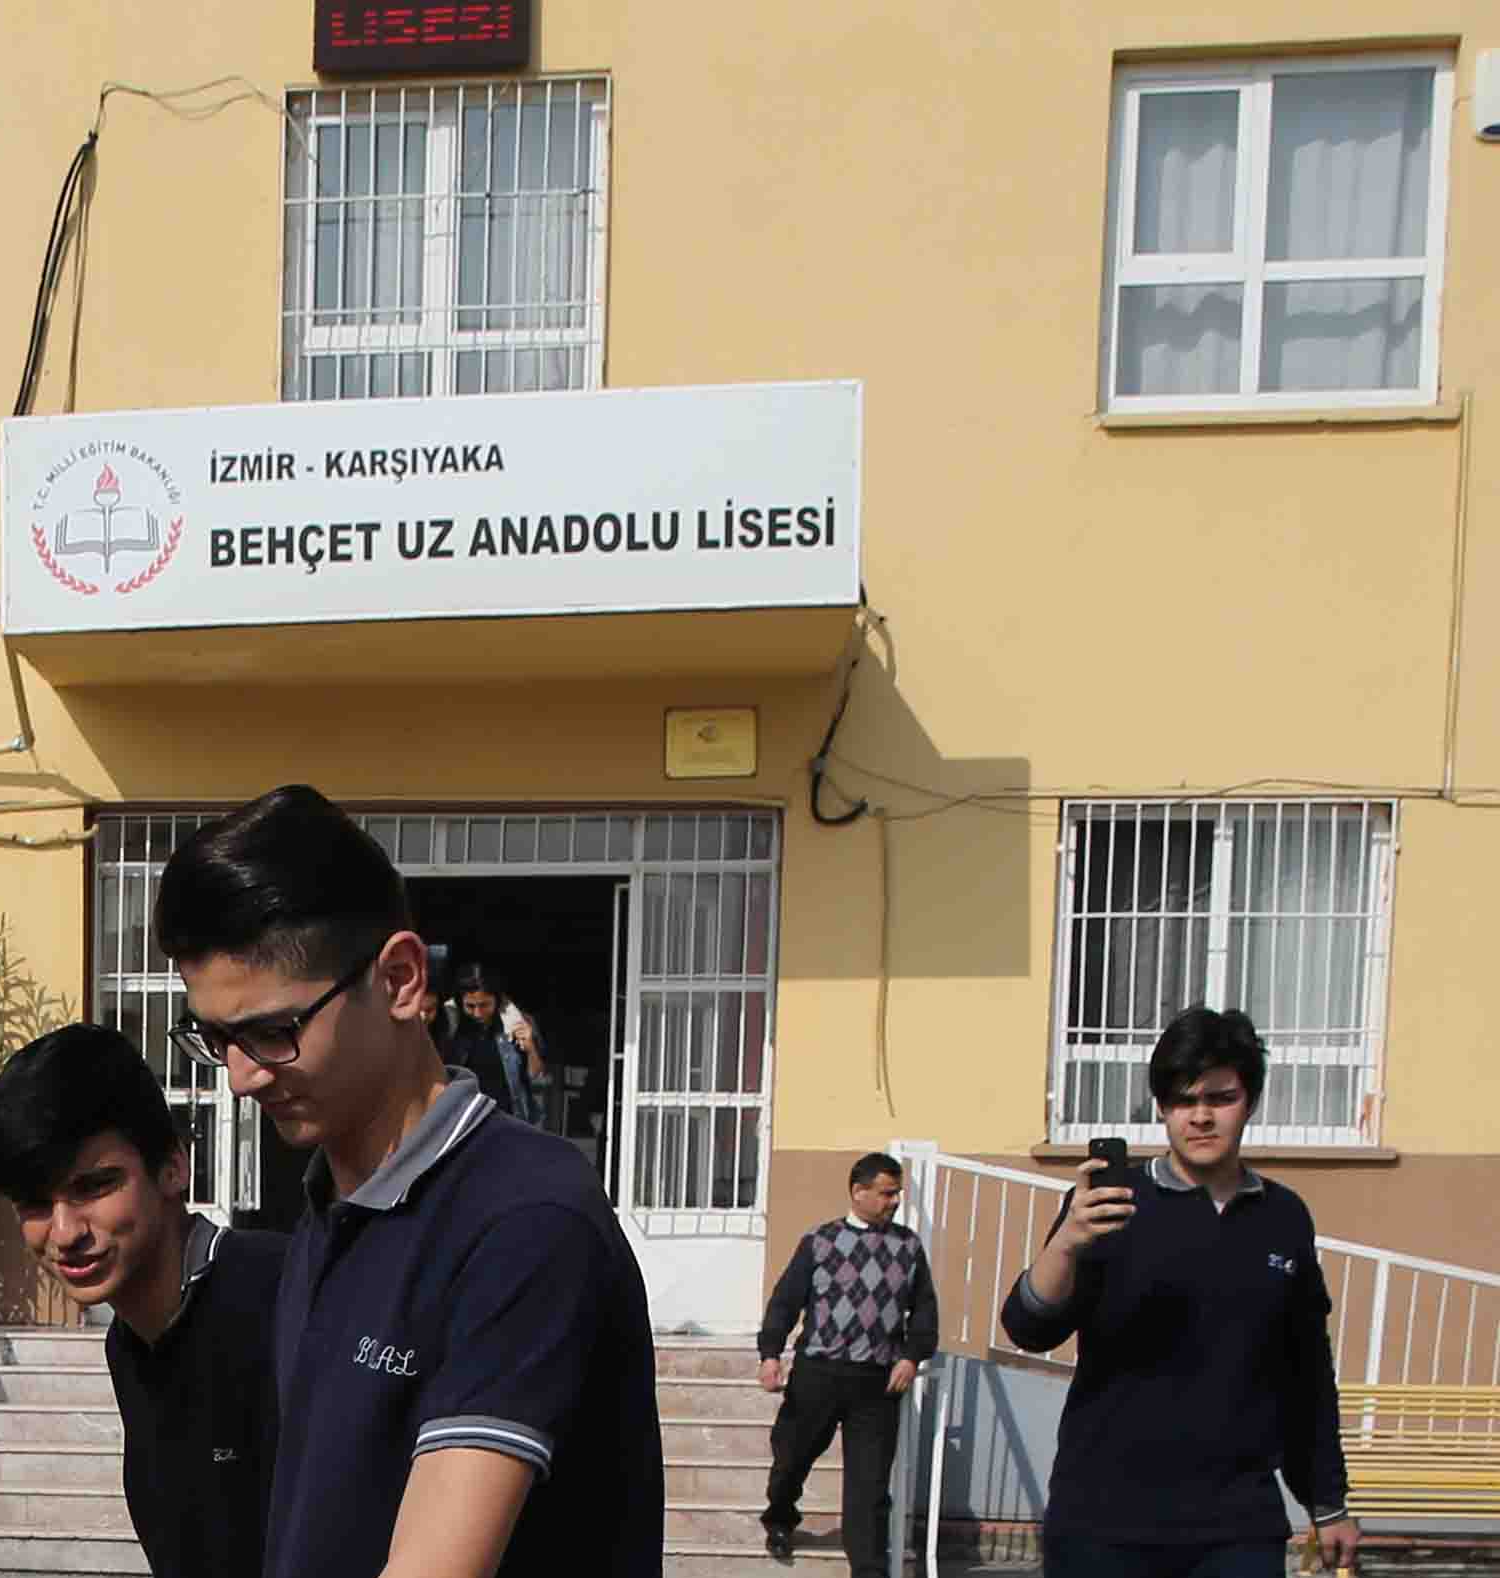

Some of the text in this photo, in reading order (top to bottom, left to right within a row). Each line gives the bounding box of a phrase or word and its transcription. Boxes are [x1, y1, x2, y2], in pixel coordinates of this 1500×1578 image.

[78, 438, 127, 460] EĞİTİM
[129, 445, 182, 505] BAKANLIĞI
[210, 447, 296, 484] İZMİR
[325, 443, 505, 483] KARŞIYAKA
[210, 495, 836, 576] BEHÇET UZ ANADOLU LİSESİ
